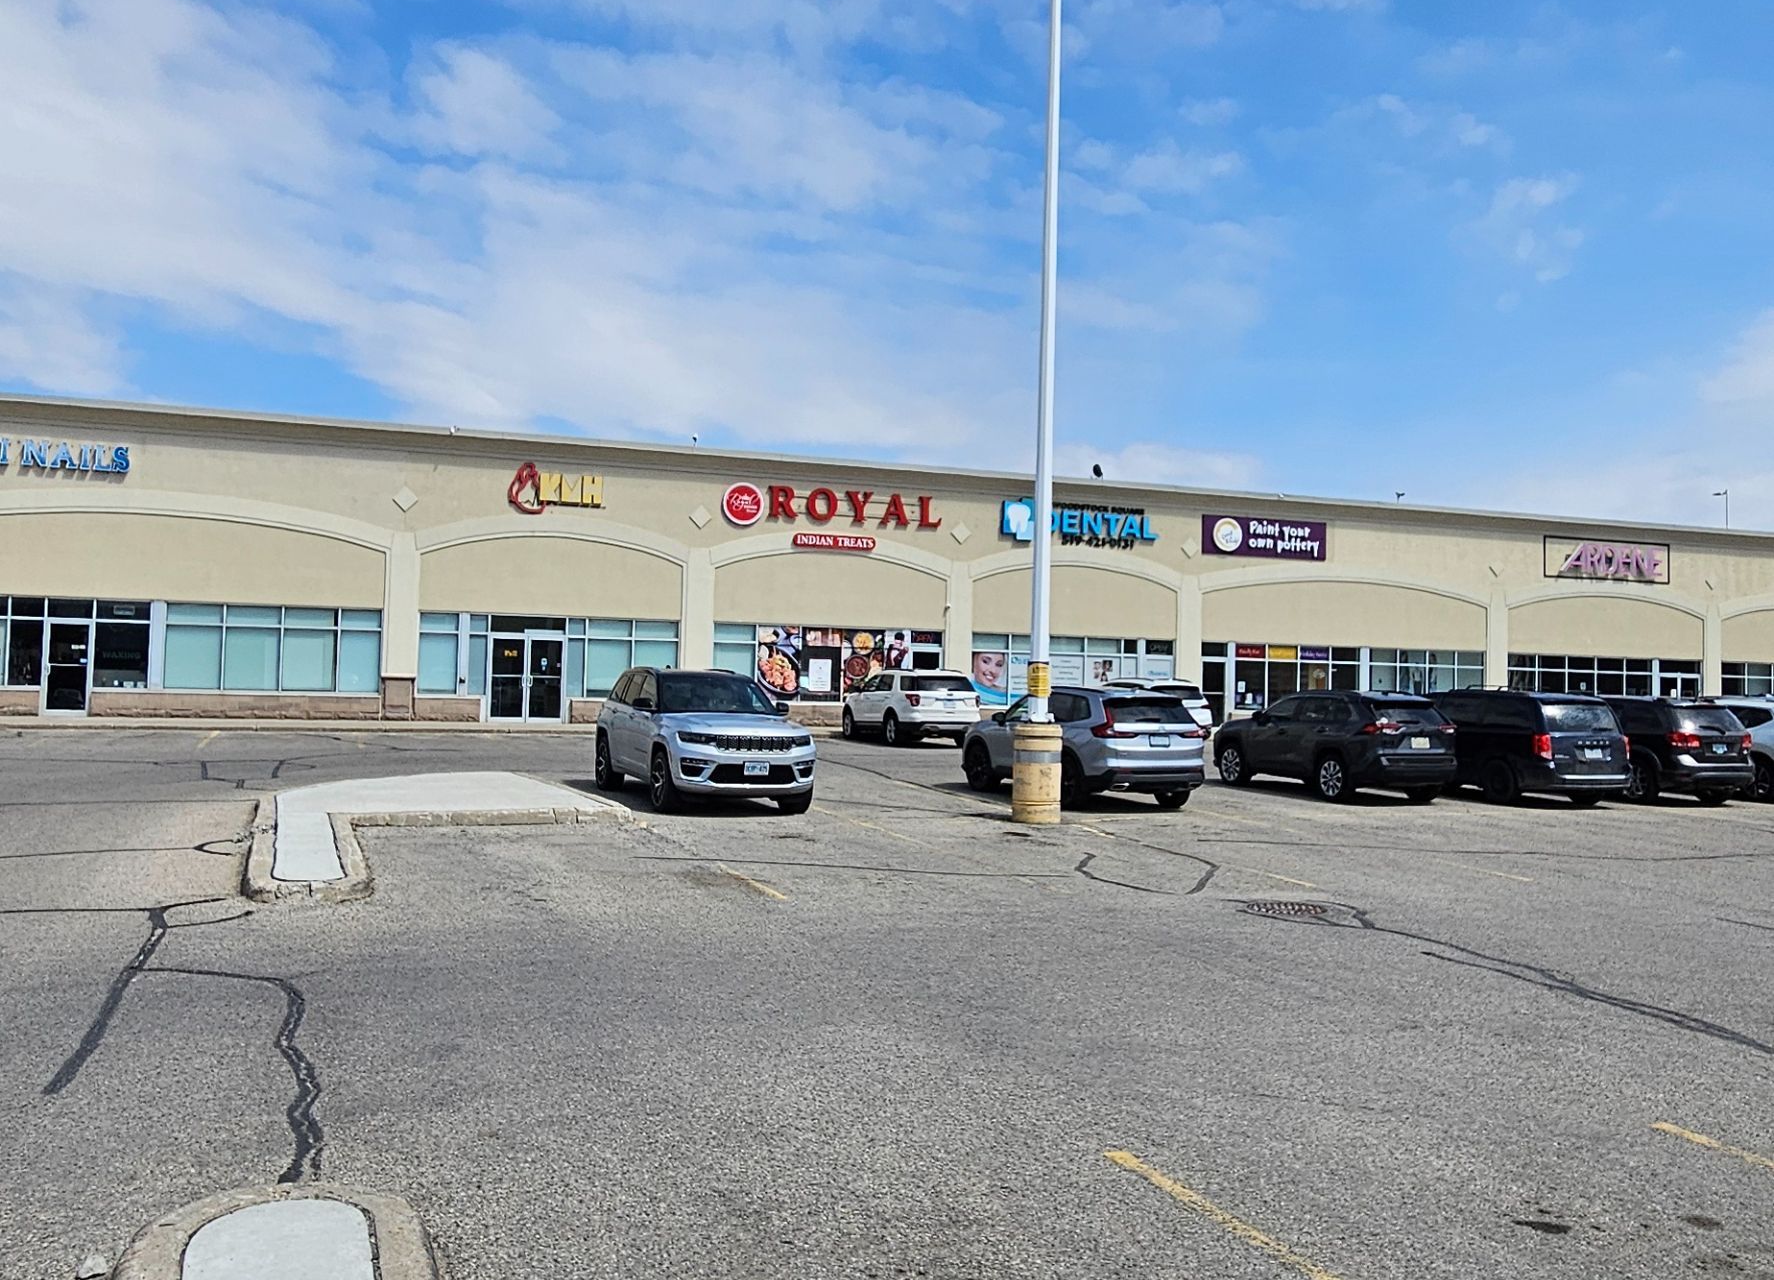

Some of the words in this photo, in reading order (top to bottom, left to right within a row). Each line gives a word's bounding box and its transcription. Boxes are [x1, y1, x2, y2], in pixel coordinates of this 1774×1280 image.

[21, 438, 131, 472] NAILS
[768, 485, 942, 528] ROYAL
[796, 535, 834, 546] INDIAN
[837, 536, 874, 549] TREATS
[1249, 520, 1280, 537] Paint
[1282, 526, 1310, 541] your
[1248, 537, 1274, 549] own
[1277, 537, 1319, 557] pottery
[1560, 542, 1664, 577] ARDENE
